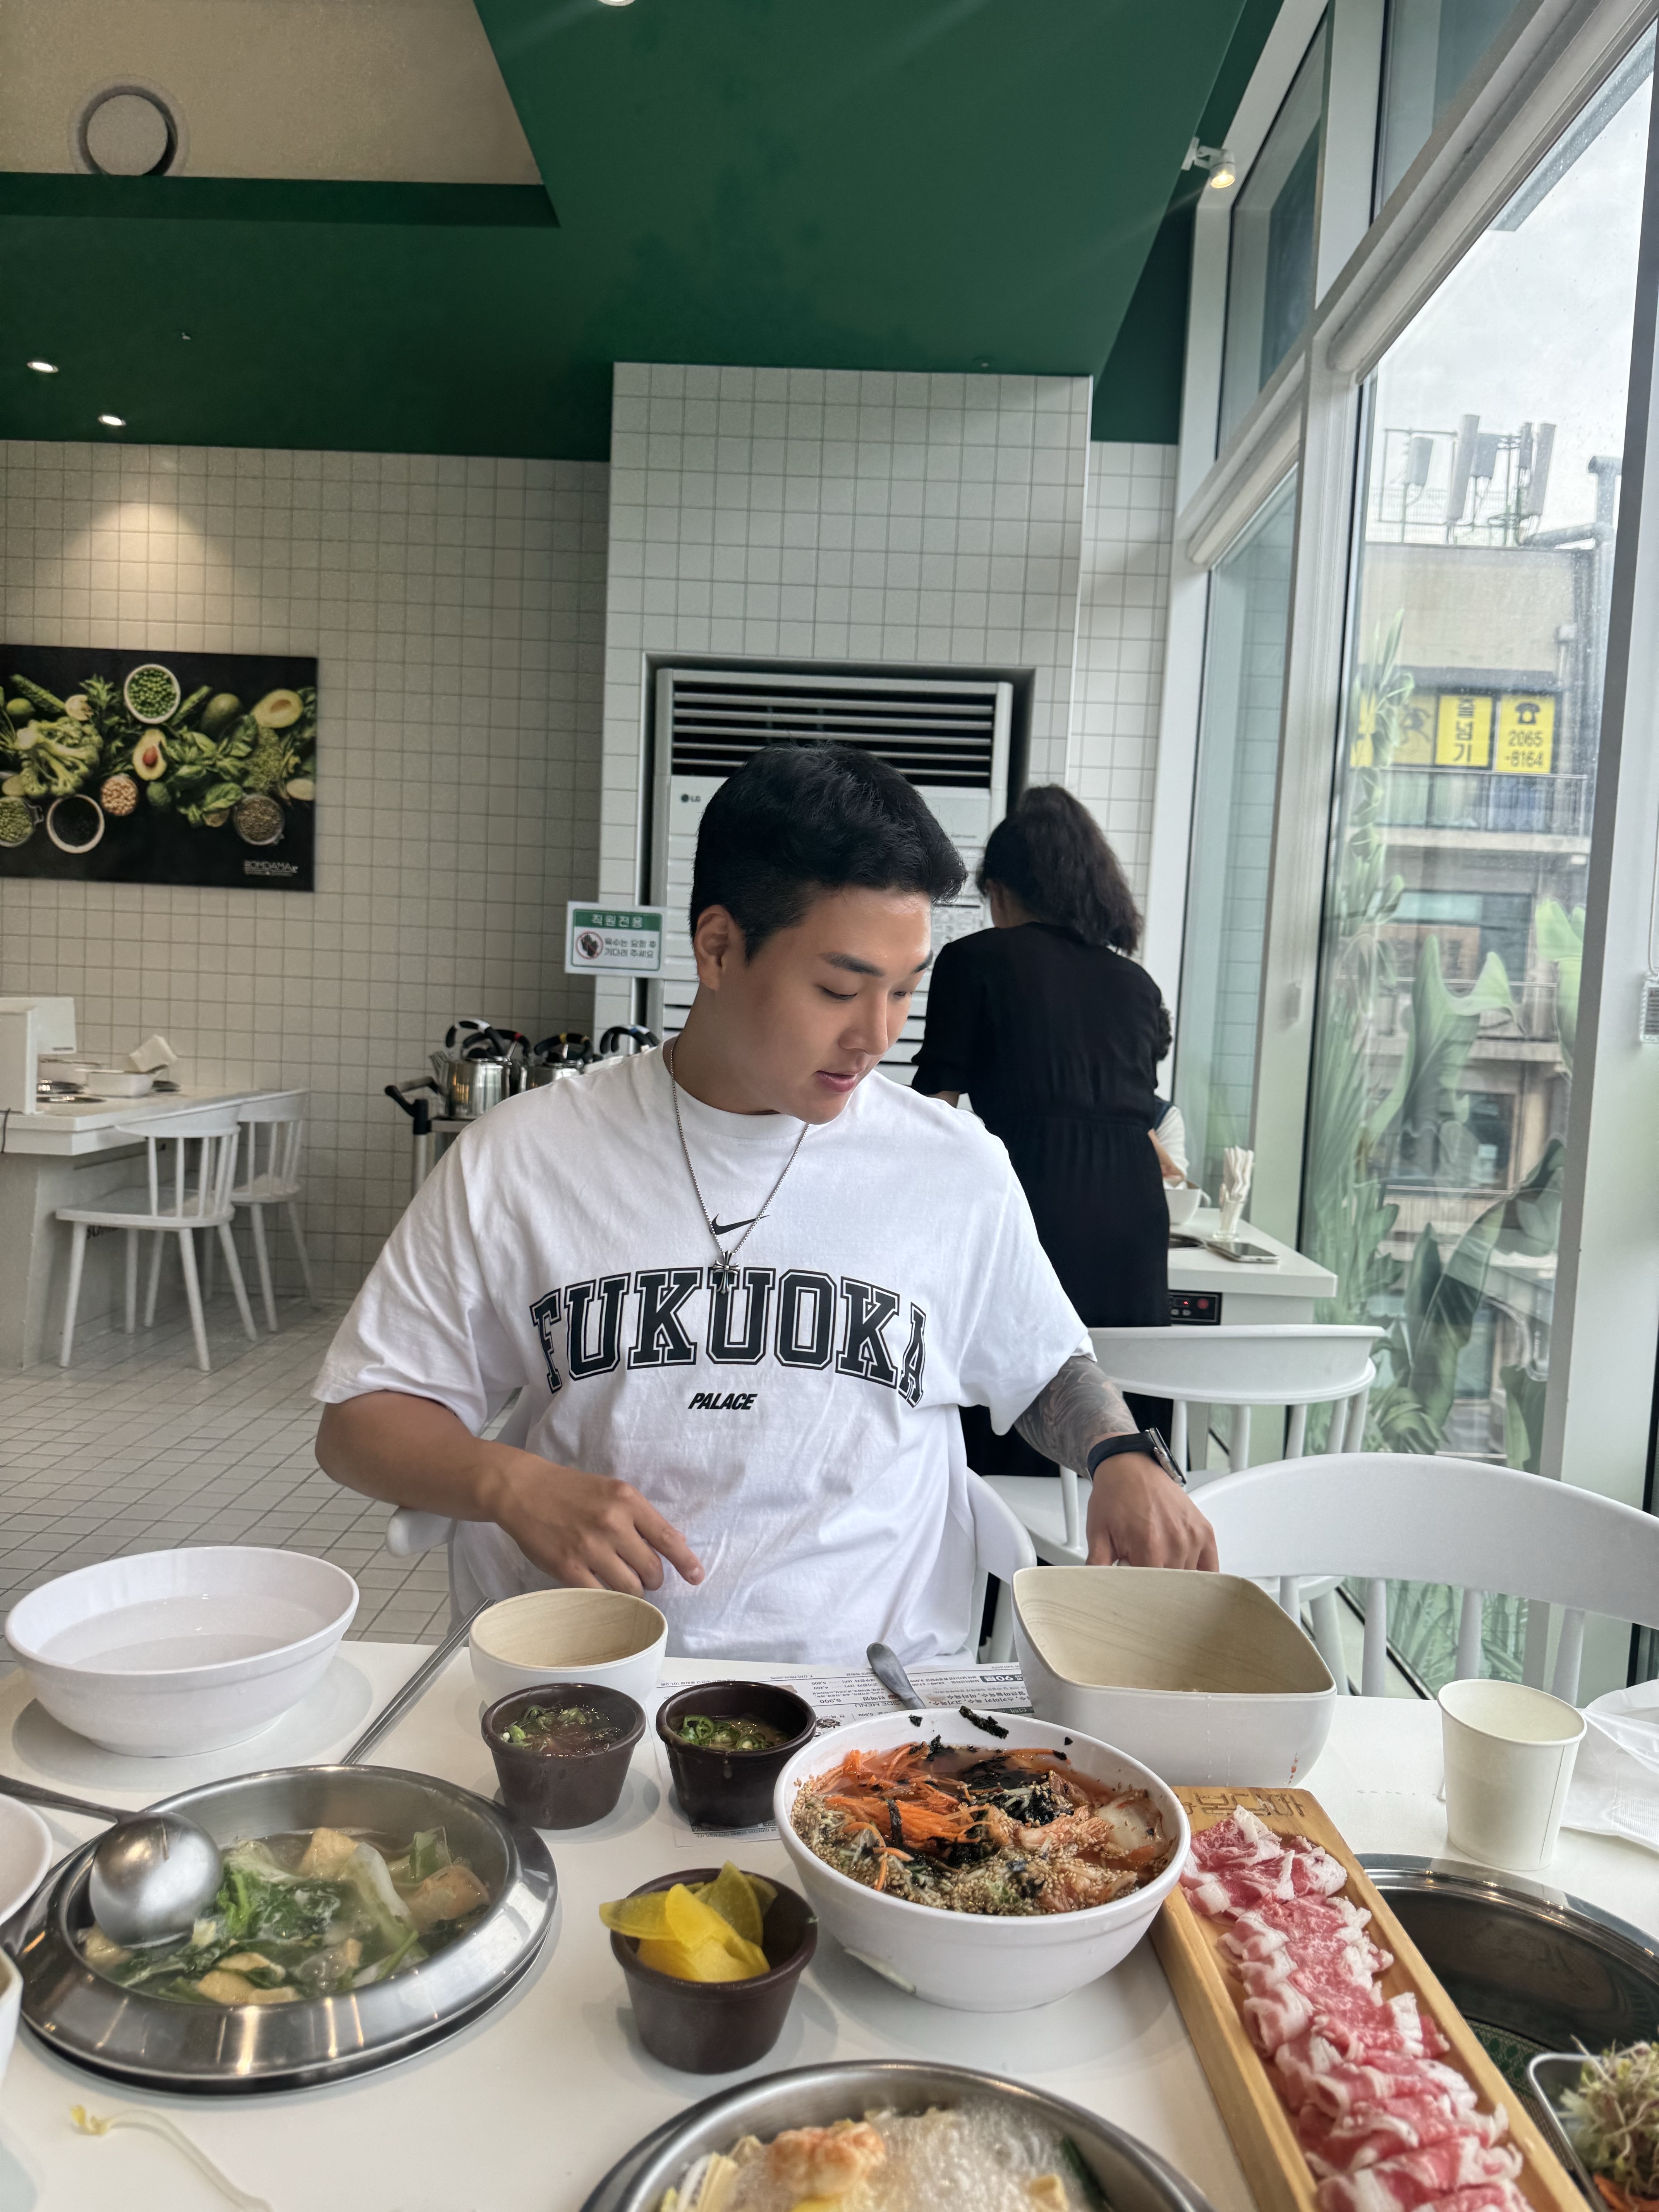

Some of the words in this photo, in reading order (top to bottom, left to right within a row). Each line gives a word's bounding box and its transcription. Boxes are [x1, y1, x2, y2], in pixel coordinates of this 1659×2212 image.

[1508, 730, 1543, 747] 2065
[592, 914, 643, 928] 직원전용
[605, 949, 628, 957] 기다려
[630, 949, 654, 958] 주세요
[529, 1266, 927, 1409] FUKUOKA
[687, 1393, 758, 1410] PALACE
